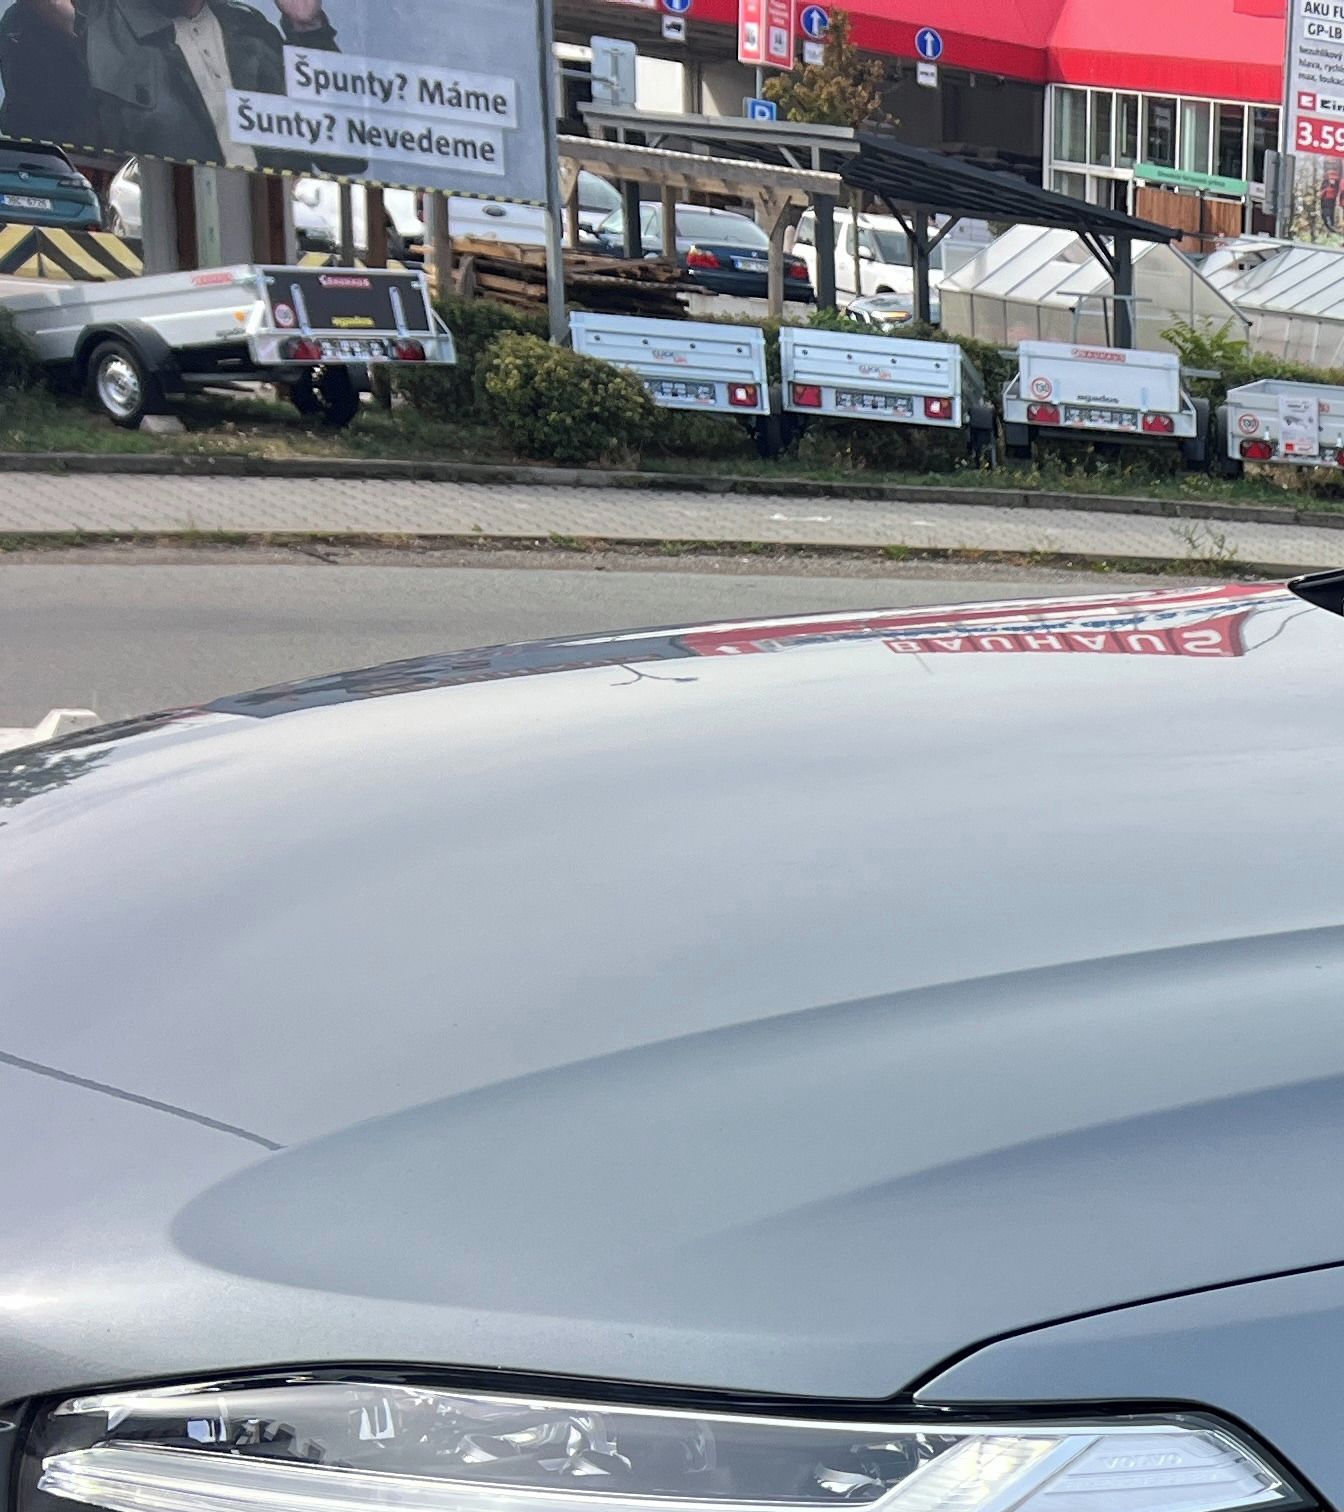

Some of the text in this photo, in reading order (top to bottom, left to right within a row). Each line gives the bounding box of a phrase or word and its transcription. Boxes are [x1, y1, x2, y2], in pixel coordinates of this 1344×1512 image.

[1304, 2, 1330, 17] AKU
[1307, 23, 1342, 39] GP-LB
[294, 54, 508, 115] Špunty? Máme
[238, 97, 496, 162] Šunty? Nevedeme
